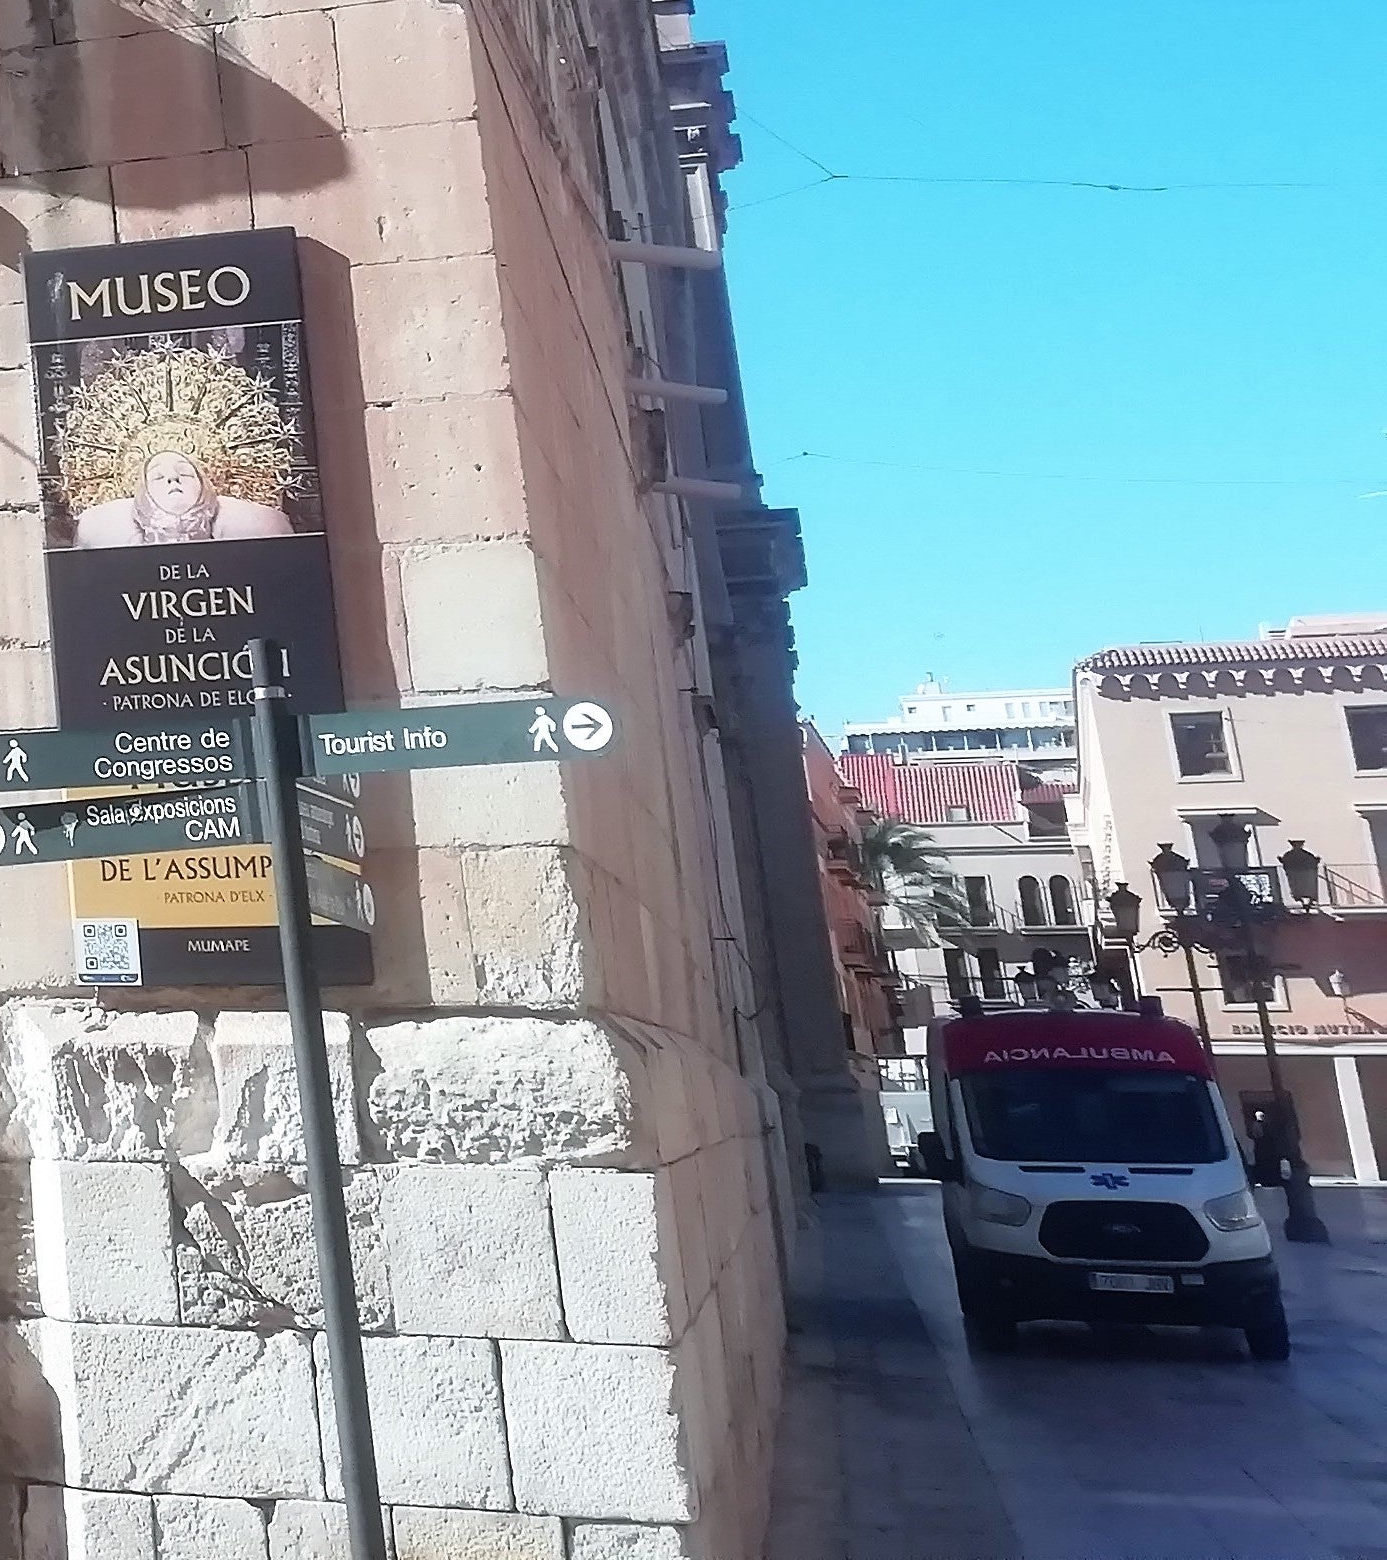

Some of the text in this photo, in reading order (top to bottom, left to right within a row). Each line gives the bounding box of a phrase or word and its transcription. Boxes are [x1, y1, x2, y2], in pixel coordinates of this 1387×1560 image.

[66, 266, 250, 321] MUSEO
[159, 564, 210, 581] DE LA
[122, 585, 255, 621] VIRGEN
[165, 627, 216, 644] DE LA
[112, 690, 257, 711] PATRONA DE ELC
[114, 727, 230, 754] Centre de
[318, 726, 448, 756] Tourist Info
[94, 755, 234, 781] Congressos
[86, 804, 126, 827] Sala
[185, 817, 242, 842] CAM
[101, 855, 273, 882] DE L'ASSUMP
[164, 889, 266, 904] PATRONA D'ELX
[187, 939, 251, 953] MUMAPE
